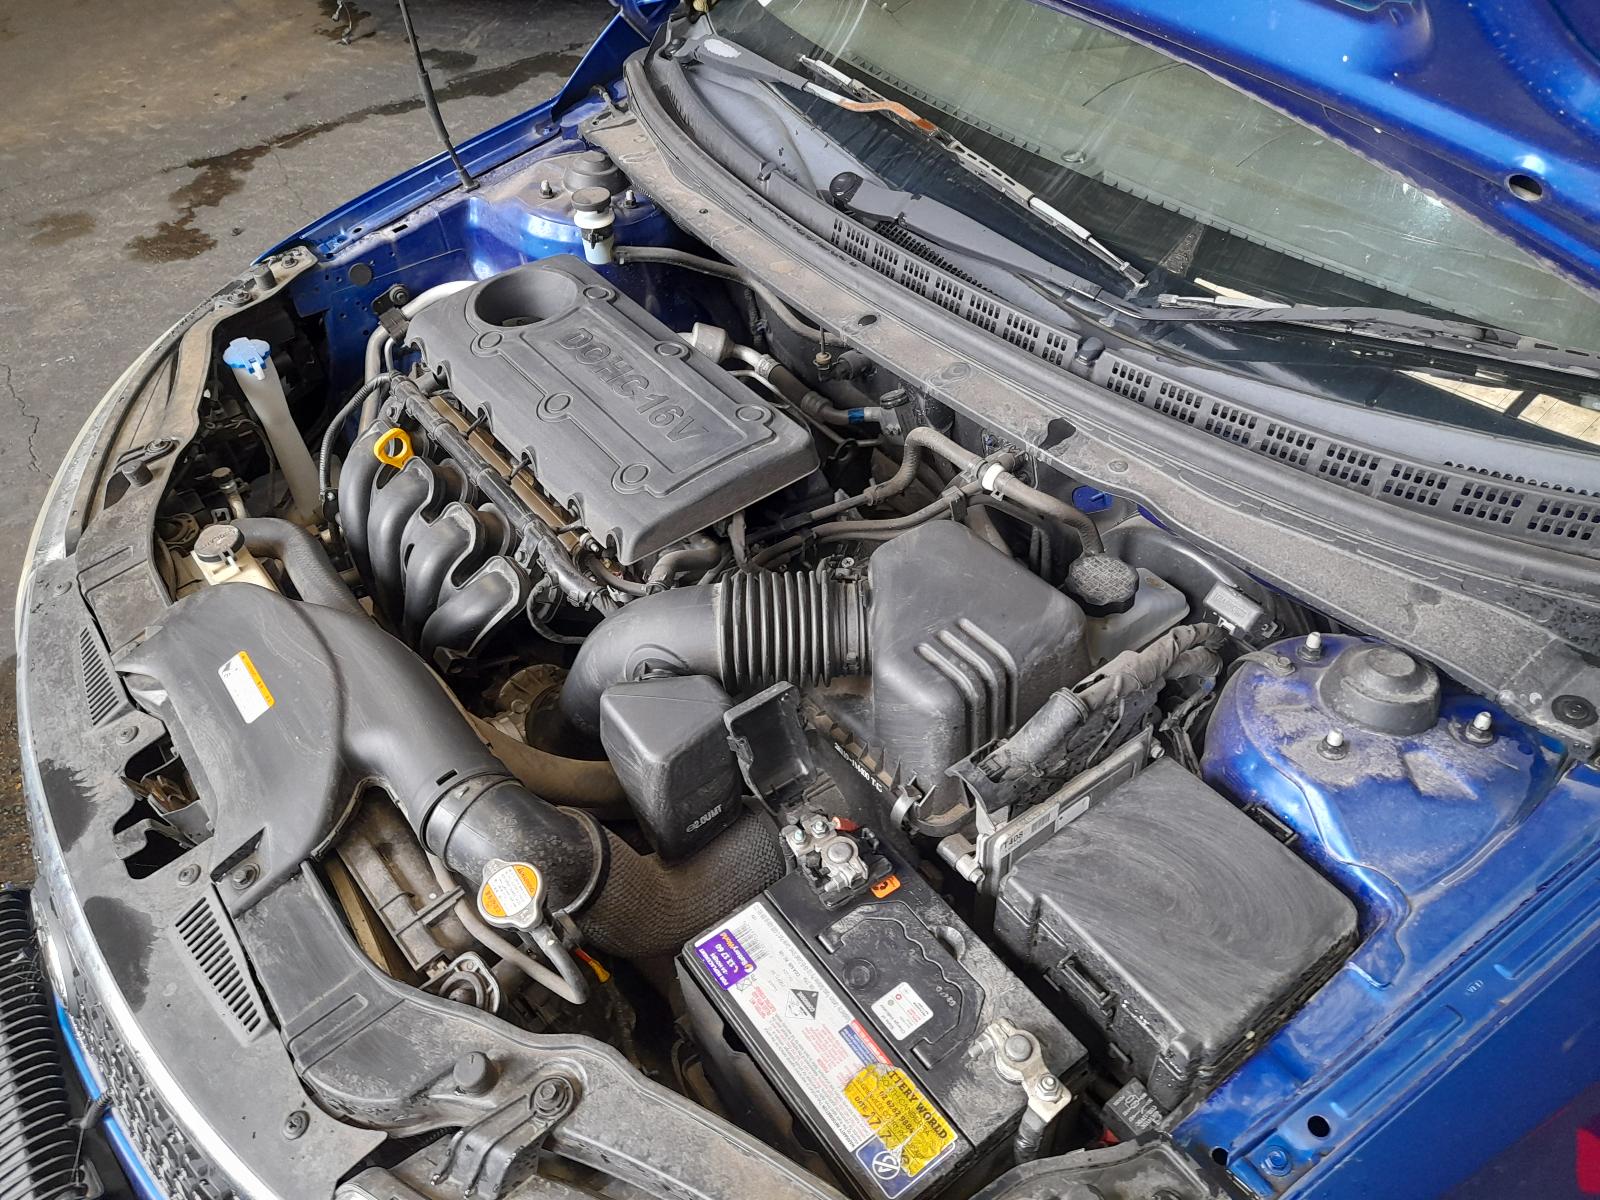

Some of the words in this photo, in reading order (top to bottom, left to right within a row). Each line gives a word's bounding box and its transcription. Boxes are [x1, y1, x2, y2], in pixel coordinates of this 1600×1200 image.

[554, 327, 650, 399] DOHC
[637, 393, 709, 442] 16V
[714, 942, 724, 952] 60
[721, 950, 730, 960] 17
[698, 947, 722, 977] REPLACEMENT
[710, 952, 723, 968] HOURS
[726, 957, 735, 967] 13
[719, 975, 728, 985] FOR
[796, 990, 815, 1013] CORROSIVE
[878, 1075, 900, 1099] SOTH
[886, 1067, 918, 1103] TTERY
[914, 1102, 948, 1140] WORLD
[898, 1115, 915, 1134] 9884
